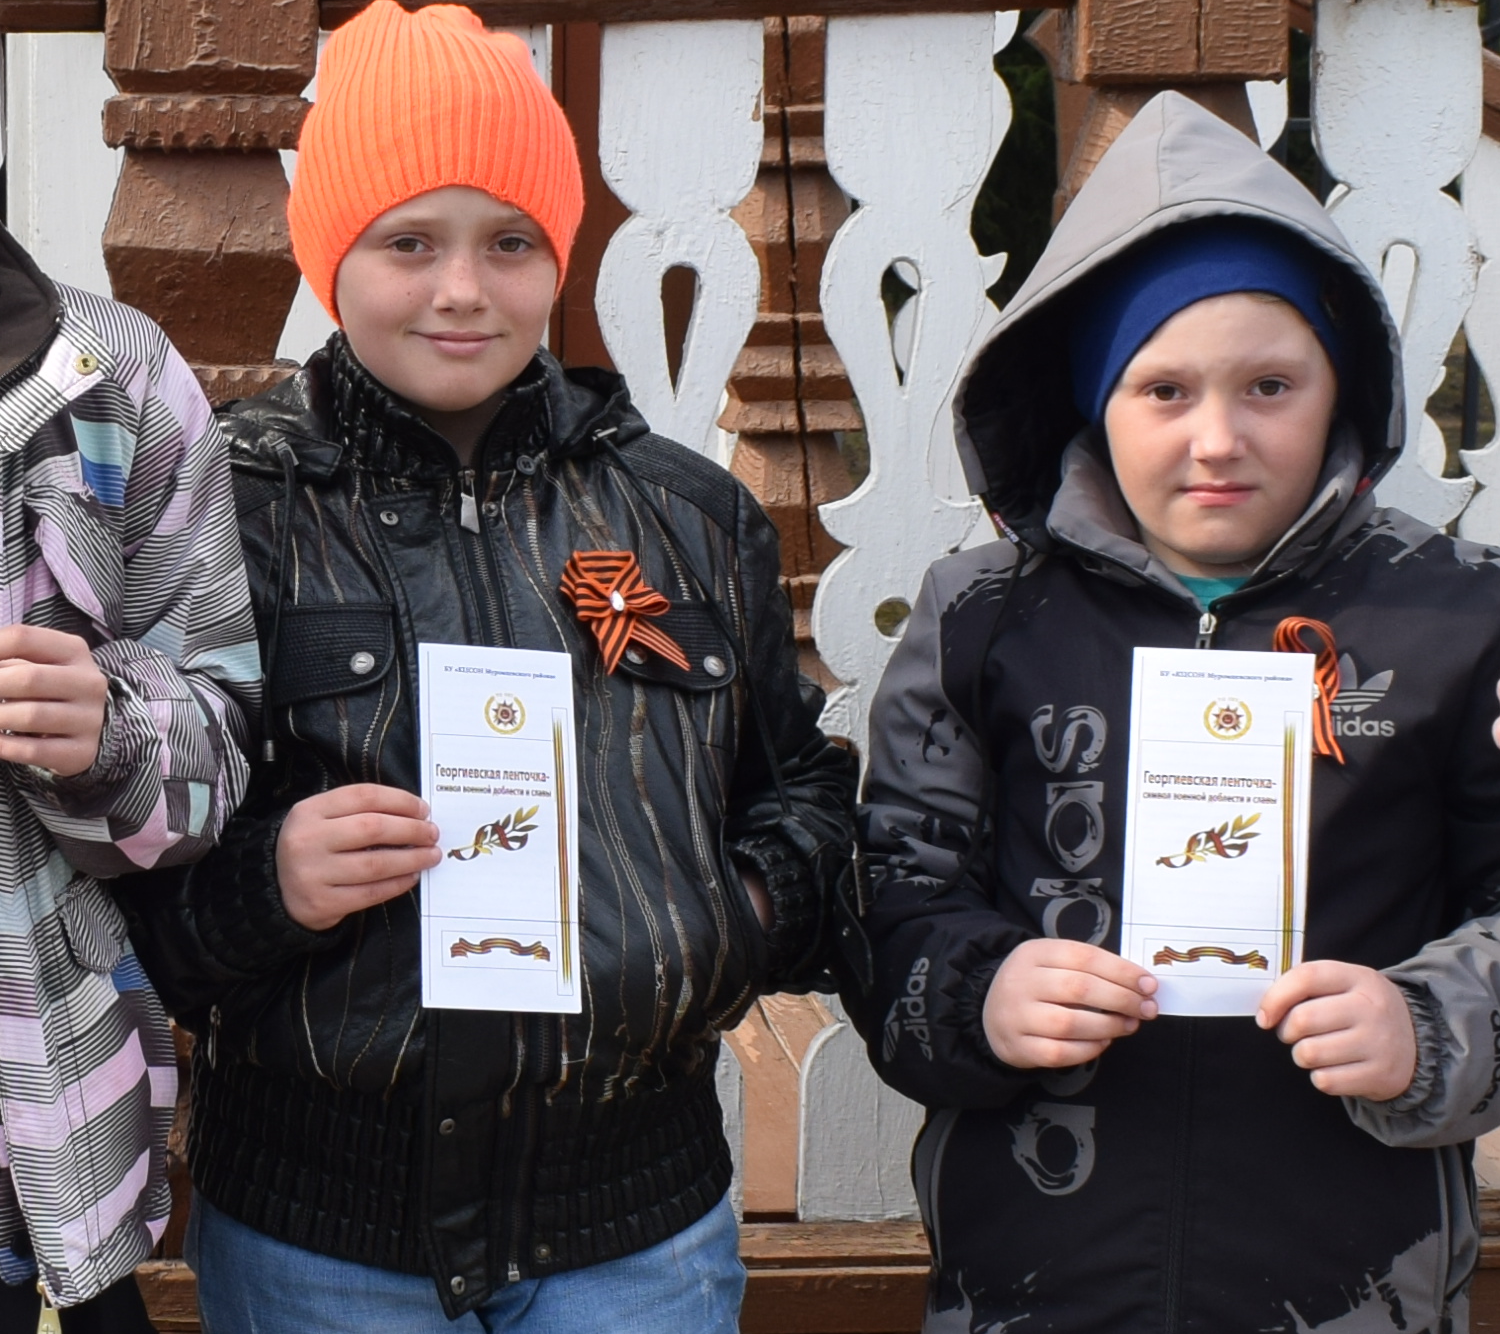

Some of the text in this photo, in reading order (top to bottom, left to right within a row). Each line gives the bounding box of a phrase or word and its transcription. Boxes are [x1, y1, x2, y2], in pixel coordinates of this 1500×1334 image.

[1331, 715, 1395, 737] idas
[435, 763, 501, 781] Георгиевская
[1143, 770, 1219, 787] Георгиевская
[900, 957, 933, 1061] adidas
